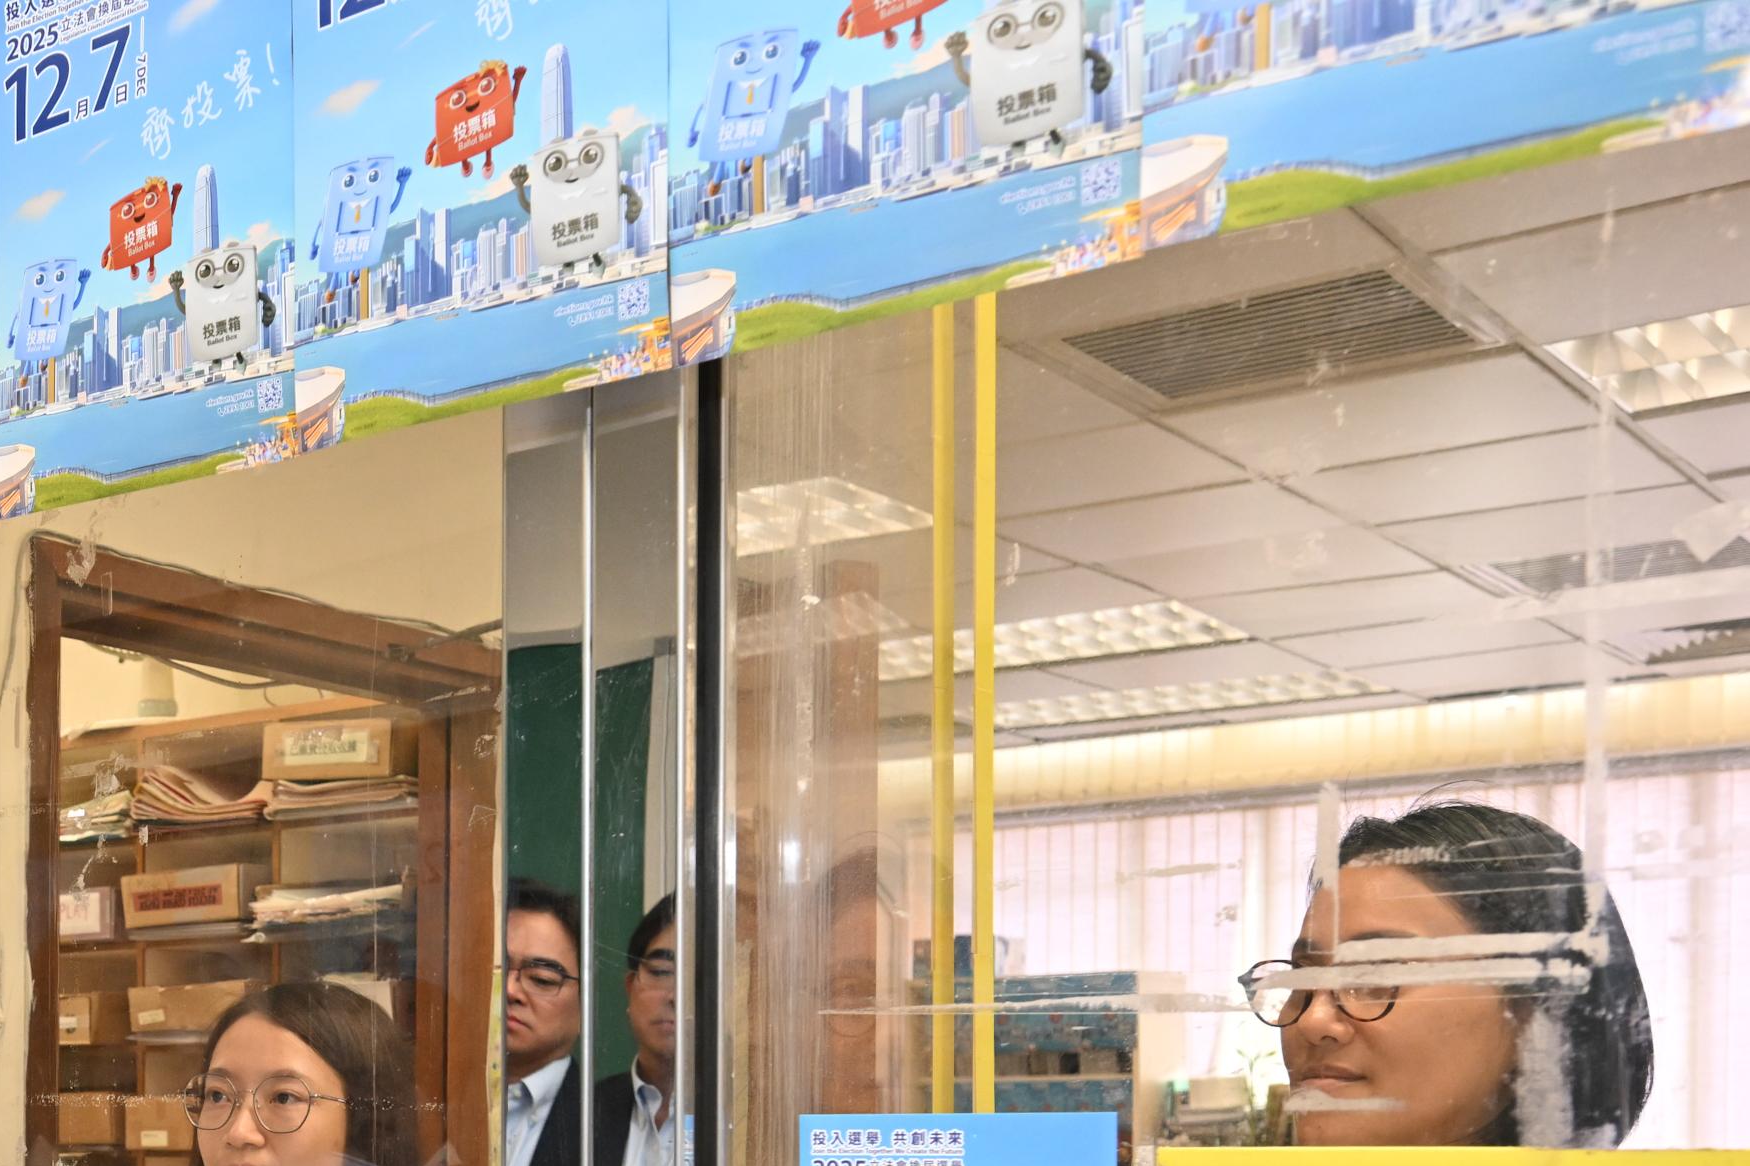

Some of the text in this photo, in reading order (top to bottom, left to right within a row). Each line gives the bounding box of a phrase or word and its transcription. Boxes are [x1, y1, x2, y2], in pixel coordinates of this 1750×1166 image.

[10, 21, 21, 32] Join
[23, 17, 32, 27] the
[34, 7, 56, 22] Election
[136, 55, 147, 96] 7 DEC
[996, 83, 1056, 115] 投票箱
[454, 109, 496, 142] 投票箱
[124, 221, 158, 248] 投票箱
[551, 213, 598, 239] 投票箱
[128, 240, 155, 257] Ballot Box
[26, 329, 56, 346] 投票箱
[202, 316, 240, 338] 投票箱
[207, 333, 237, 346] Ballot Box
[813, 1132, 962, 1145] 投入選舉 共創未來
